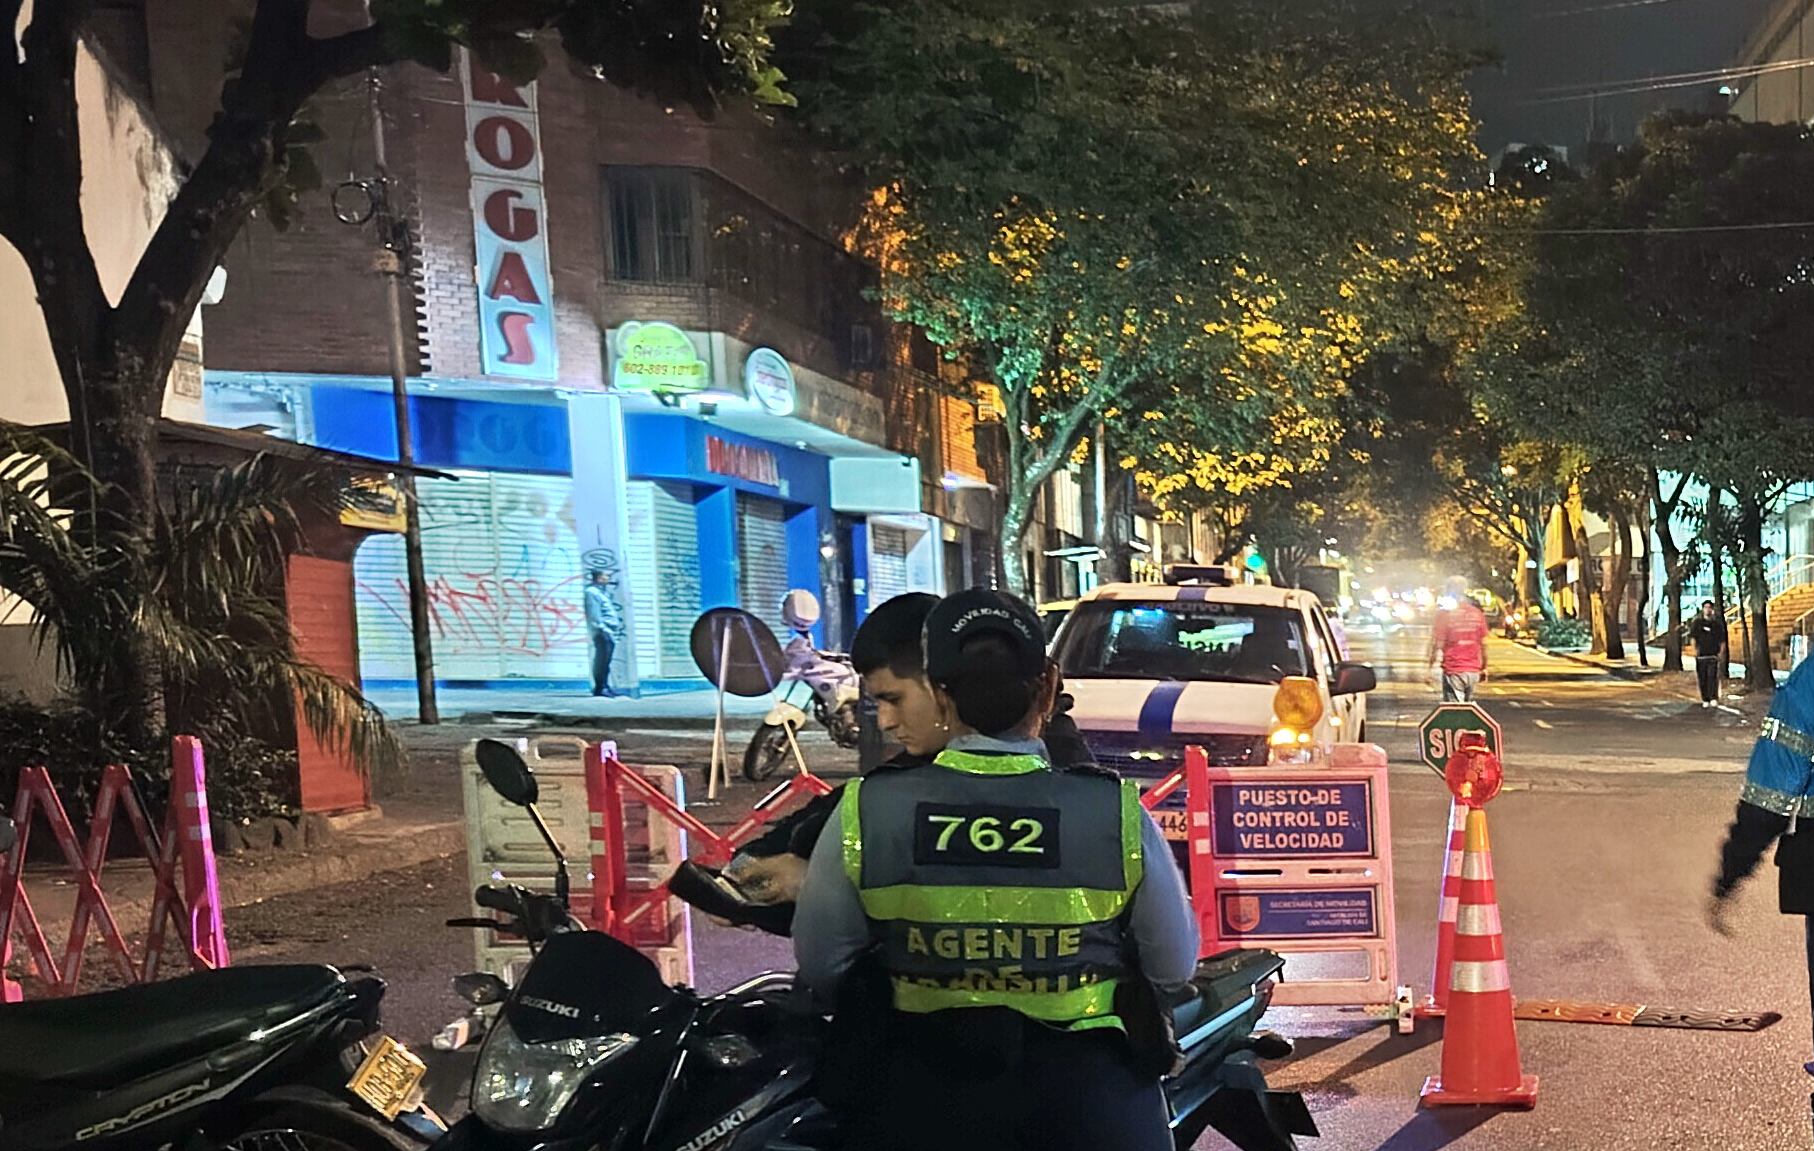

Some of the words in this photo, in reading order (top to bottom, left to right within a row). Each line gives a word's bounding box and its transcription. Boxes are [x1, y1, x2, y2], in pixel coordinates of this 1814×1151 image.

[951, 608, 1010, 633] MOVILIDAD
[1239, 790, 1309, 806] PUESTO
[1316, 790, 1341, 805] DE
[1233, 812, 1320, 828] CONTROL
[1326, 811, 1349, 827] DE
[928, 814, 1045, 853] 762
[1240, 832, 1344, 849] VELOCIDAD
[906, 927, 1082, 960] AGENTE
[520, 995, 580, 1018] SUZUKI
